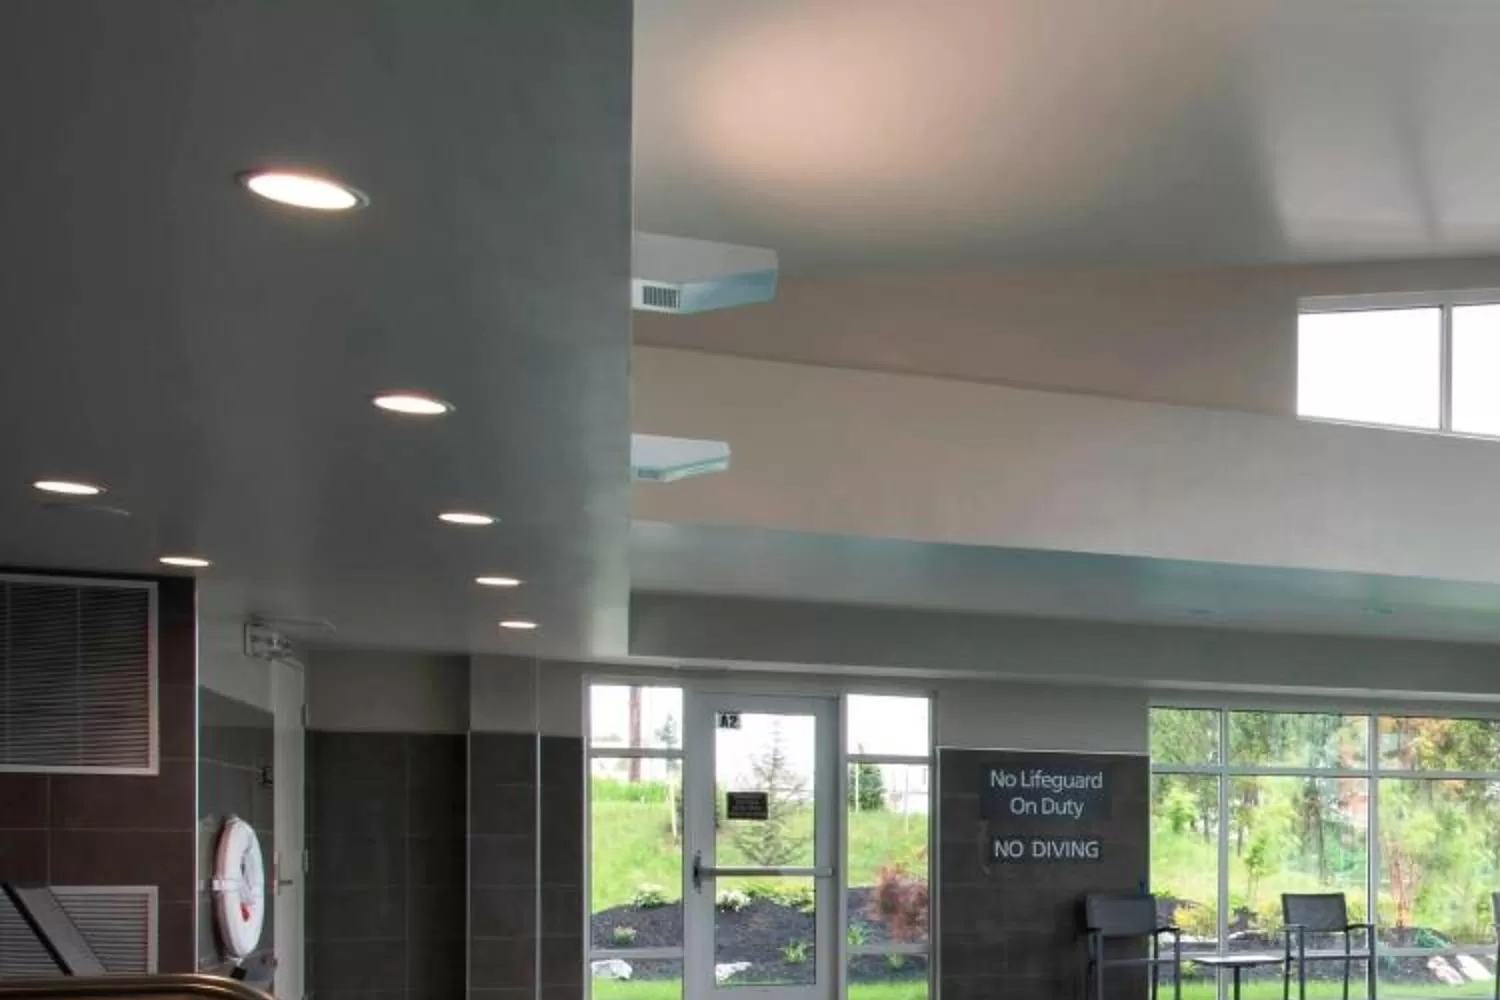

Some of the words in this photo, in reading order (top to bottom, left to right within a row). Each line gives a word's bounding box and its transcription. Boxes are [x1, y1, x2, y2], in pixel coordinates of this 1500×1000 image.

[720, 715, 737, 729] A2
[990, 769, 1017, 788] No
[1020, 769, 1103, 792] Lifeguard
[1009, 797, 1037, 815] On
[1041, 797, 1085, 819] Duty
[994, 839, 1024, 858] NO
[1031, 839, 1100, 859] DIVING
